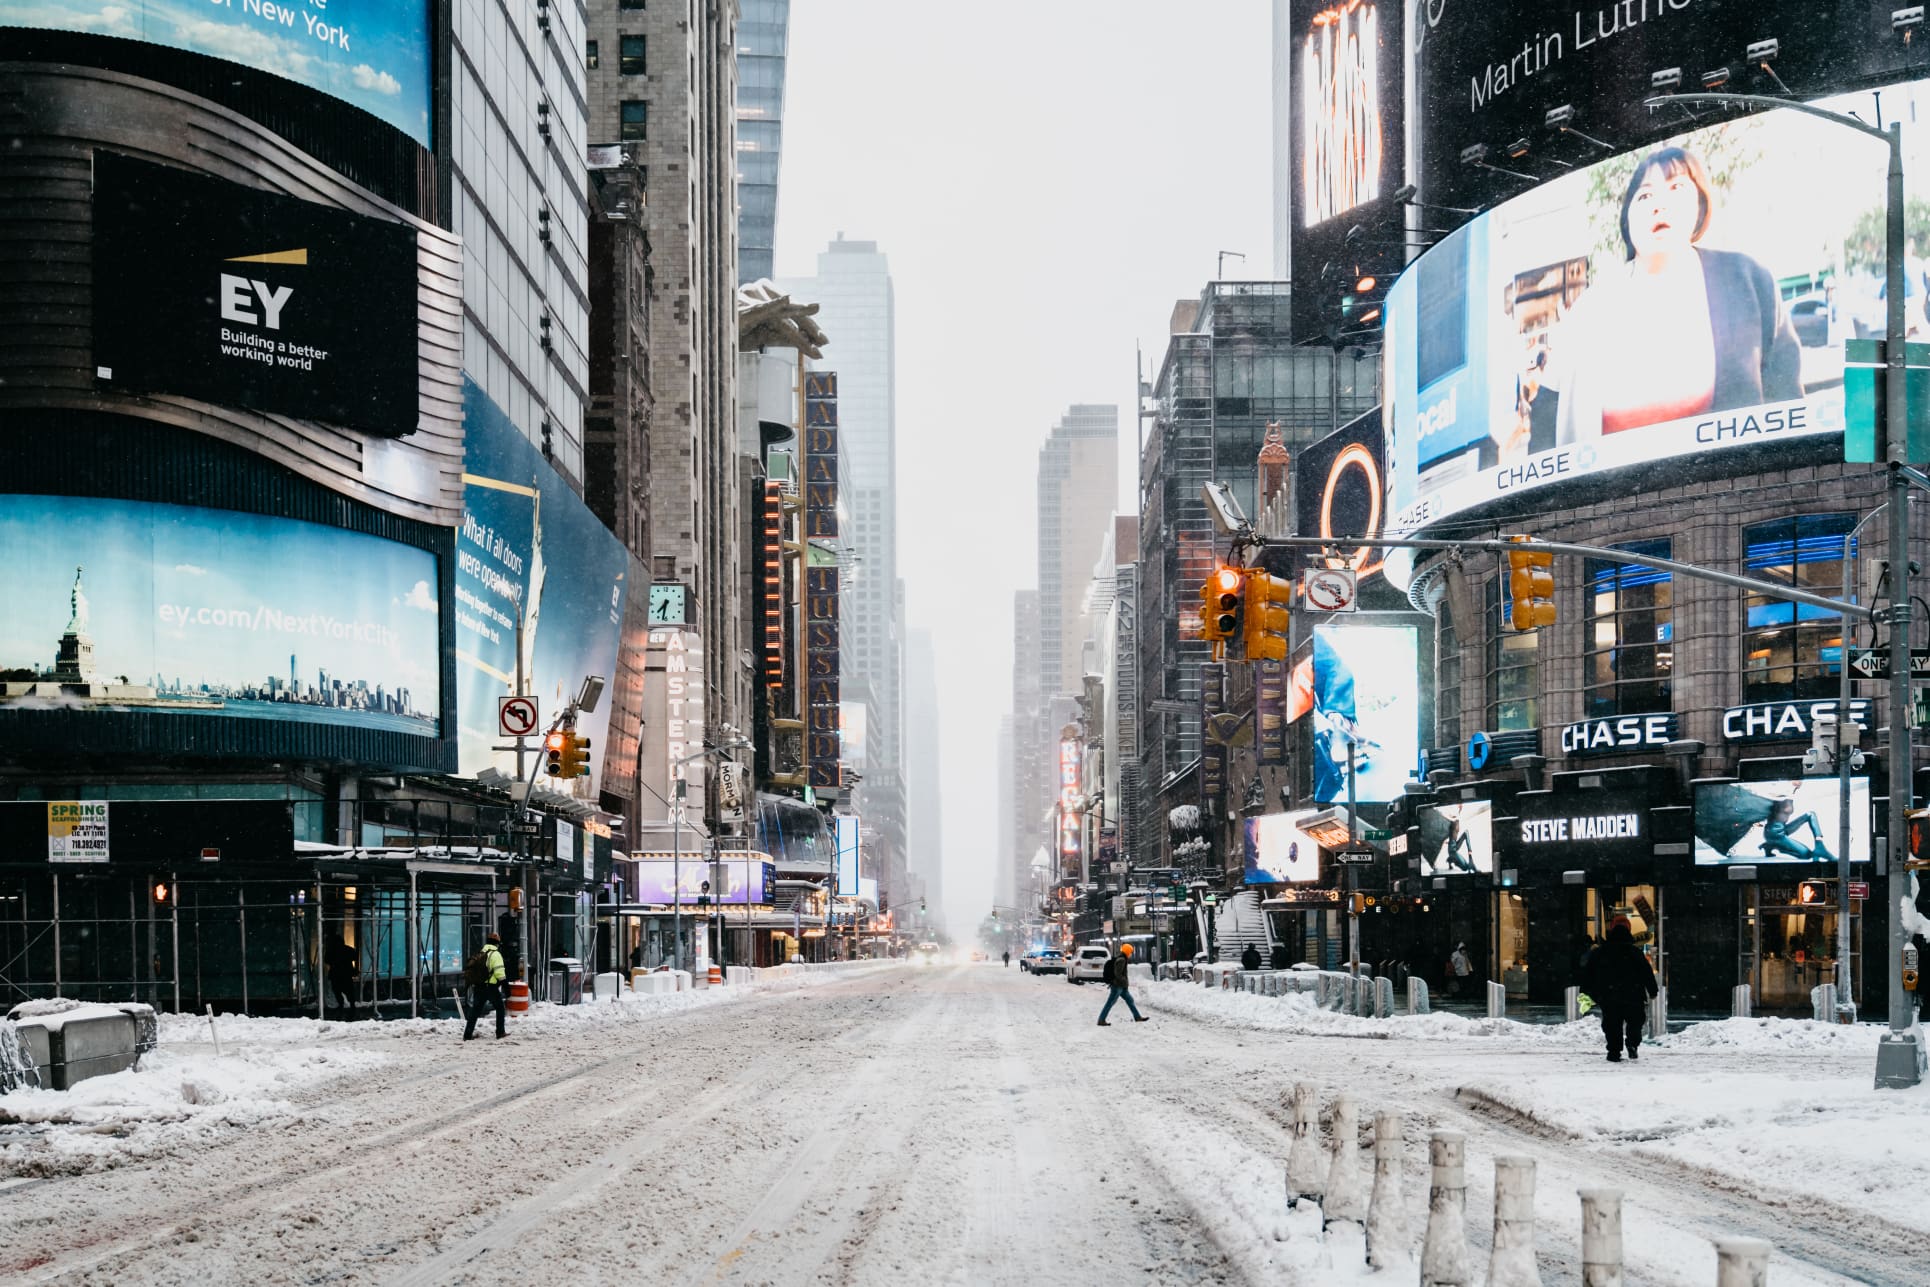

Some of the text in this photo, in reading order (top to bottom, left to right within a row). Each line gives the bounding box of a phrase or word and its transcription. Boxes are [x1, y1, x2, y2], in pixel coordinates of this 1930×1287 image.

[243, 0, 350, 51] New York
[1471, 32, 1562, 113] Martin
[220, 272, 294, 330] EY
[221, 327, 328, 360] Building a better
[221, 344, 312, 371] working world
[1418, 389, 1457, 441] ocal
[1696, 406, 1807, 443] CHASE
[809, 373, 835, 535] MADAME
[1497, 452, 1570, 491] CHASE
[459, 549, 481, 579] were
[486, 527, 494, 553] if
[493, 537, 504, 561] all
[503, 543, 523, 576] doors
[649, 633, 666, 643] NEW
[810, 570, 836, 786] TUSSAUDS
[1117, 653, 1135, 714] STUDIOS
[1861, 658, 1887, 671] ONE
[1561, 716, 1671, 753] CHASE
[1723, 701, 1867, 739] CHASE
[52, 805, 106, 816] SPRING
[1061, 742, 1079, 852] REGAL
[1521, 813, 1639, 843] STEVE MADDEN
[1763, 888, 1793, 900] STEVE
